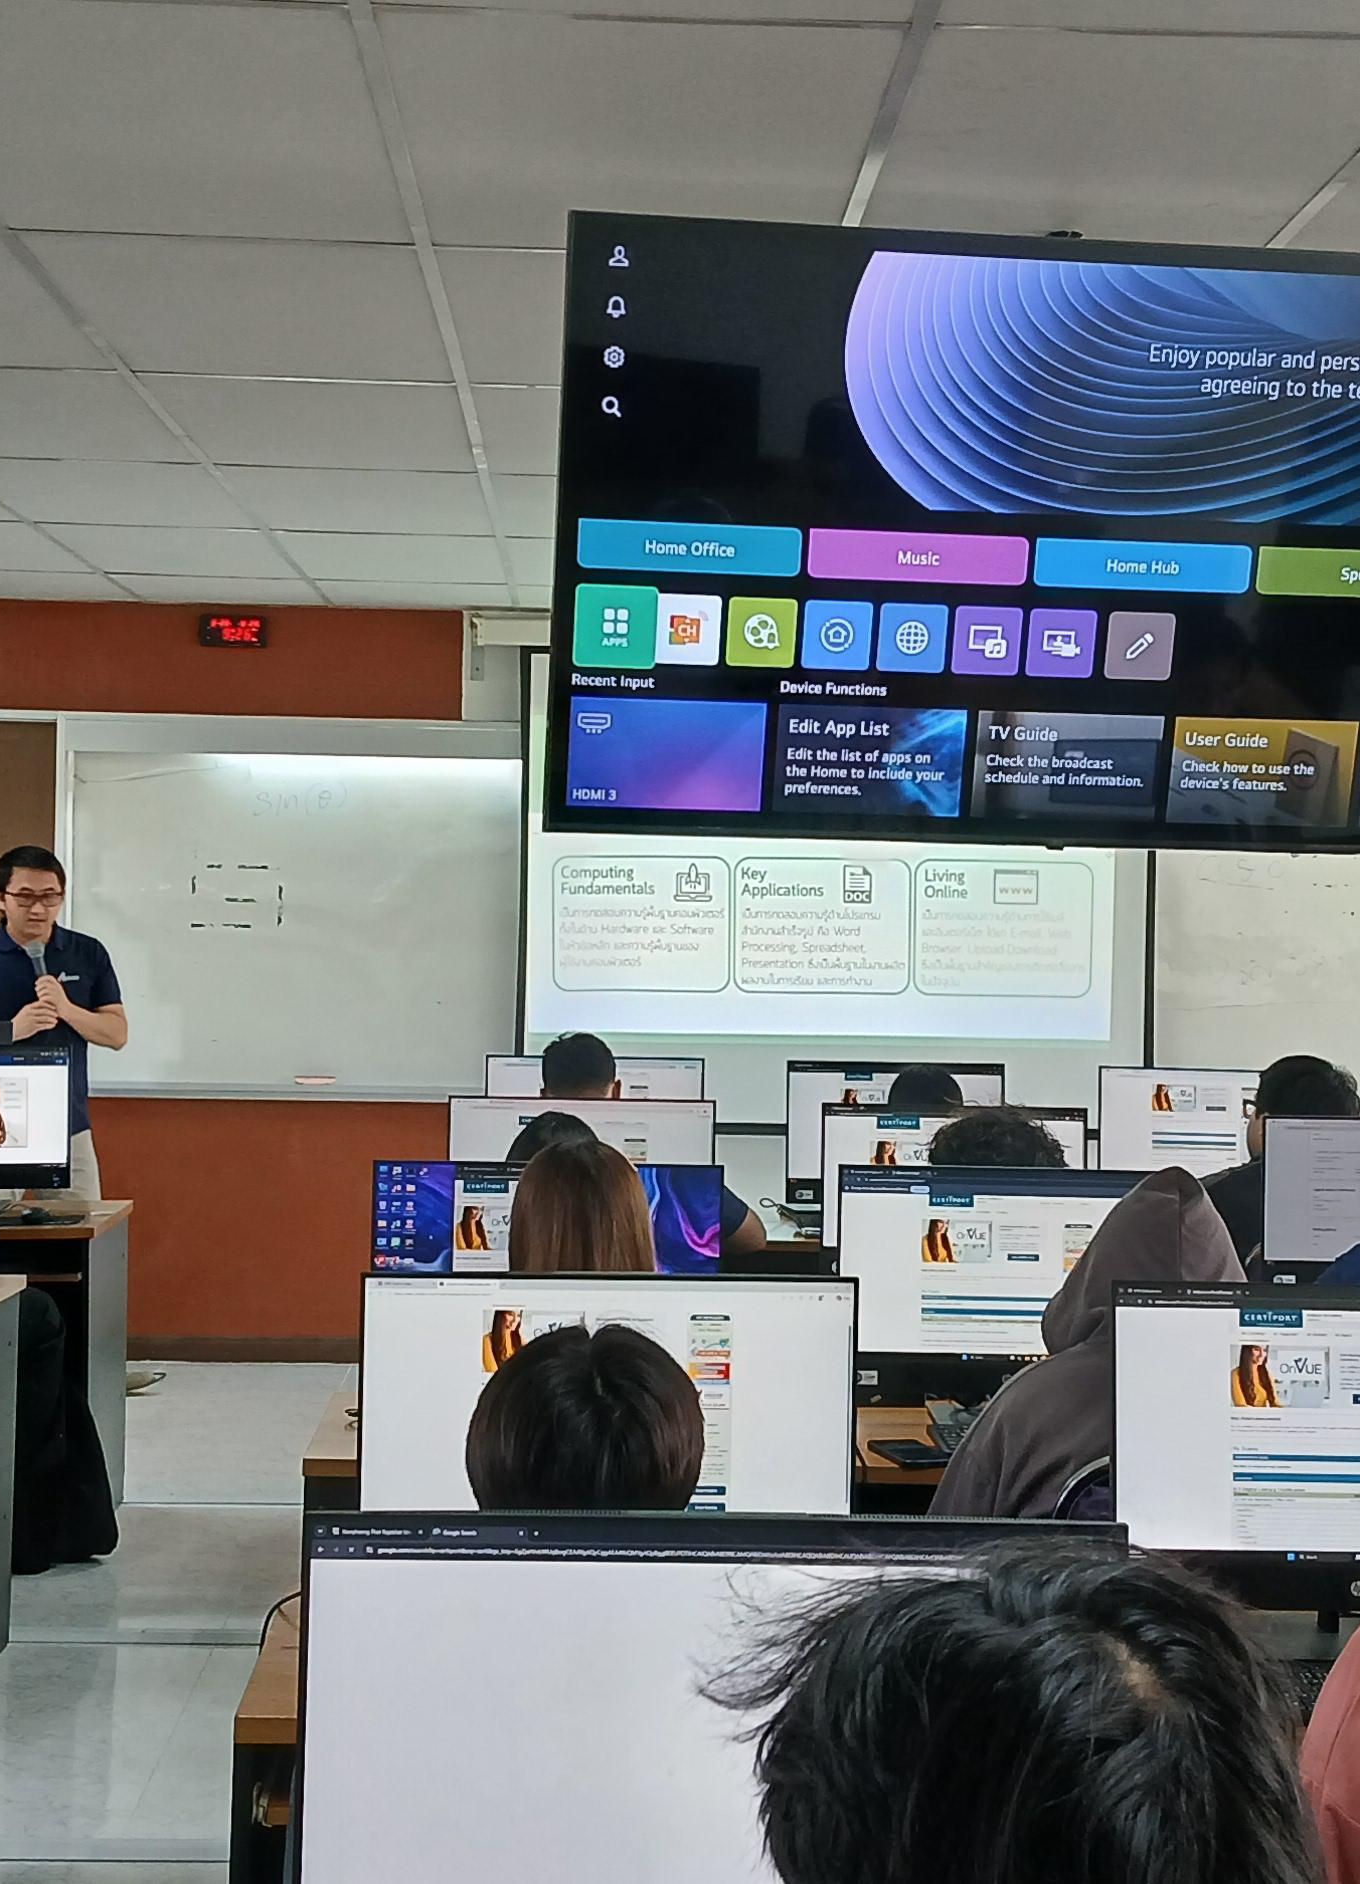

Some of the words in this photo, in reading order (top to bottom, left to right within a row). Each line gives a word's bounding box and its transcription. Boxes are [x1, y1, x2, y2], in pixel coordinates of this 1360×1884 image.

[1149, 344, 1200, 369] Enjoy
[1205, 348, 1277, 372] popular
[1281, 350, 1315, 369] and
[1200, 377, 1280, 400] agreeing
[1287, 380, 1306, 396] to
[1312, 379, 1346, 398] the
[645, 540, 687, 555] Home
[691, 542, 734, 557] Office
[898, 551, 939, 566] Music
[1107, 559, 1146, 573] Home
[1149, 560, 1179, 574] Hub
[678, 623, 697, 637] CH
[602, 637, 628, 648] APPS
[572, 673, 617, 687] Recent
[621, 675, 655, 690] Input
[780, 681, 822, 695] Device
[826, 682, 887, 697] Functions
[789, 719, 820, 733] Edit
[824, 720, 855, 738] App
[861, 721, 889, 736] List
[988, 726, 1011, 741] TV
[1014, 727, 1058, 743] Guide
[1186, 732, 1221, 747] User
[1225, 733, 1269, 748] Guide
[787, 748, 813, 762] Edit
[817, 749, 837, 762] the
[841, 749, 861, 762] list
[865, 750, 879, 763] of
[882, 754, 911, 768] apps
[915, 754, 931, 764] on
[986, 754, 1024, 769] Check
[1028, 756, 1048, 770] the
[1052, 757, 1113, 771] broadcast
[786, 764, 807, 778] the
[811, 766, 847, 779] Home
[851, 768, 865, 779] to
[868, 767, 912, 781] include
[915, 771, 944, 784] your
[1183, 760, 1219, 774] Check
[1223, 761, 1249, 774] how
[1252, 763, 1265, 774] to
[1269, 764, 1290, 775] use
[1293, 763, 1314, 776] the
[984, 772, 1039, 785] schedule
[1042, 773, 1065, 786] and
[1068, 773, 1144, 788] information.
[1181, 776, 1229, 790] device's
[1233, 777, 1288, 791] features.
[573, 789, 605, 801] HDMI
[608, 790, 617, 801] 3
[785, 782, 862, 797] preferences.
[560, 865, 634, 882] Computing
[741, 867, 767, 884] Key
[925, 868, 966, 886] Living
[560, 880, 656, 896] Fundamentals
[741, 882, 825, 899] Applications
[924, 884, 969, 899] Online
[844, 892, 870, 901] DOC
[601, 923, 649, 935] Hardware
[670, 923, 714, 936] Software
[833, 926, 861, 937] Word
[741, 957, 804, 969] Presentation
[1280, 1357, 1322, 1375] OnVUE
